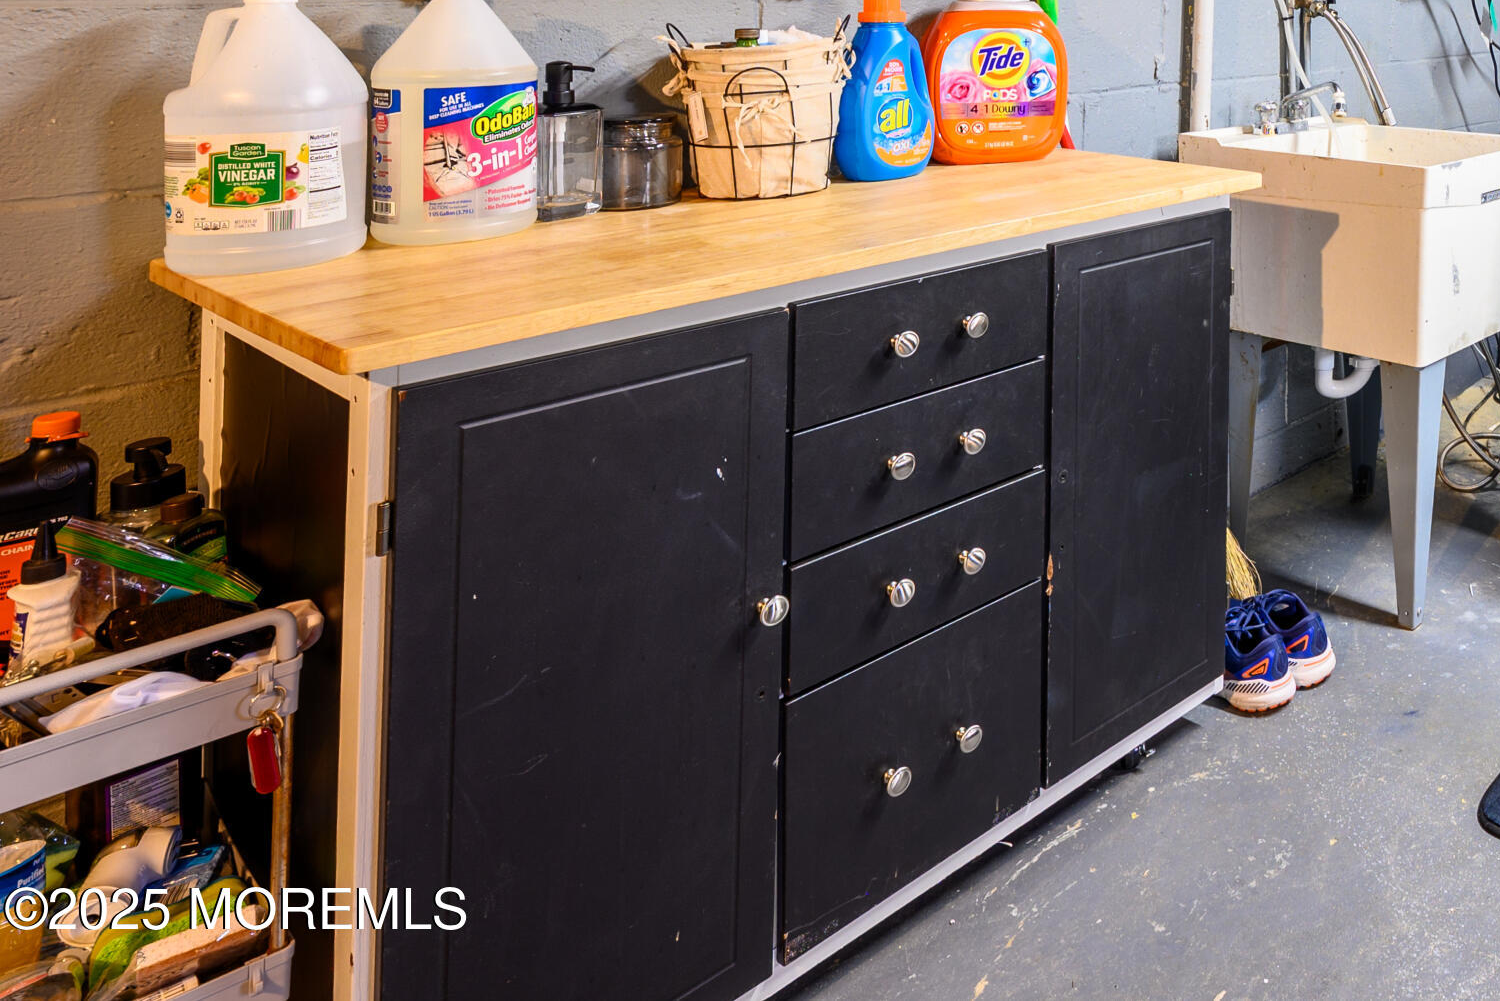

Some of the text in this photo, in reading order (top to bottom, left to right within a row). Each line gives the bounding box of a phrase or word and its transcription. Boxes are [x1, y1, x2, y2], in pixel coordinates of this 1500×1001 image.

[978, 44, 1025, 76] Tide
[441, 92, 466, 108] SAFE
[983, 89, 1018, 101] PODS
[879, 98, 910, 133] all
[991, 103, 1026, 116] Downy
[475, 102, 536, 137] OdoBan
[484, 125, 521, 143] Eliminates
[217, 161, 276, 170] DISTILLED WHITE
[467, 137, 523, 177] 3-in-1
[218, 169, 276, 183] VINEGAR
